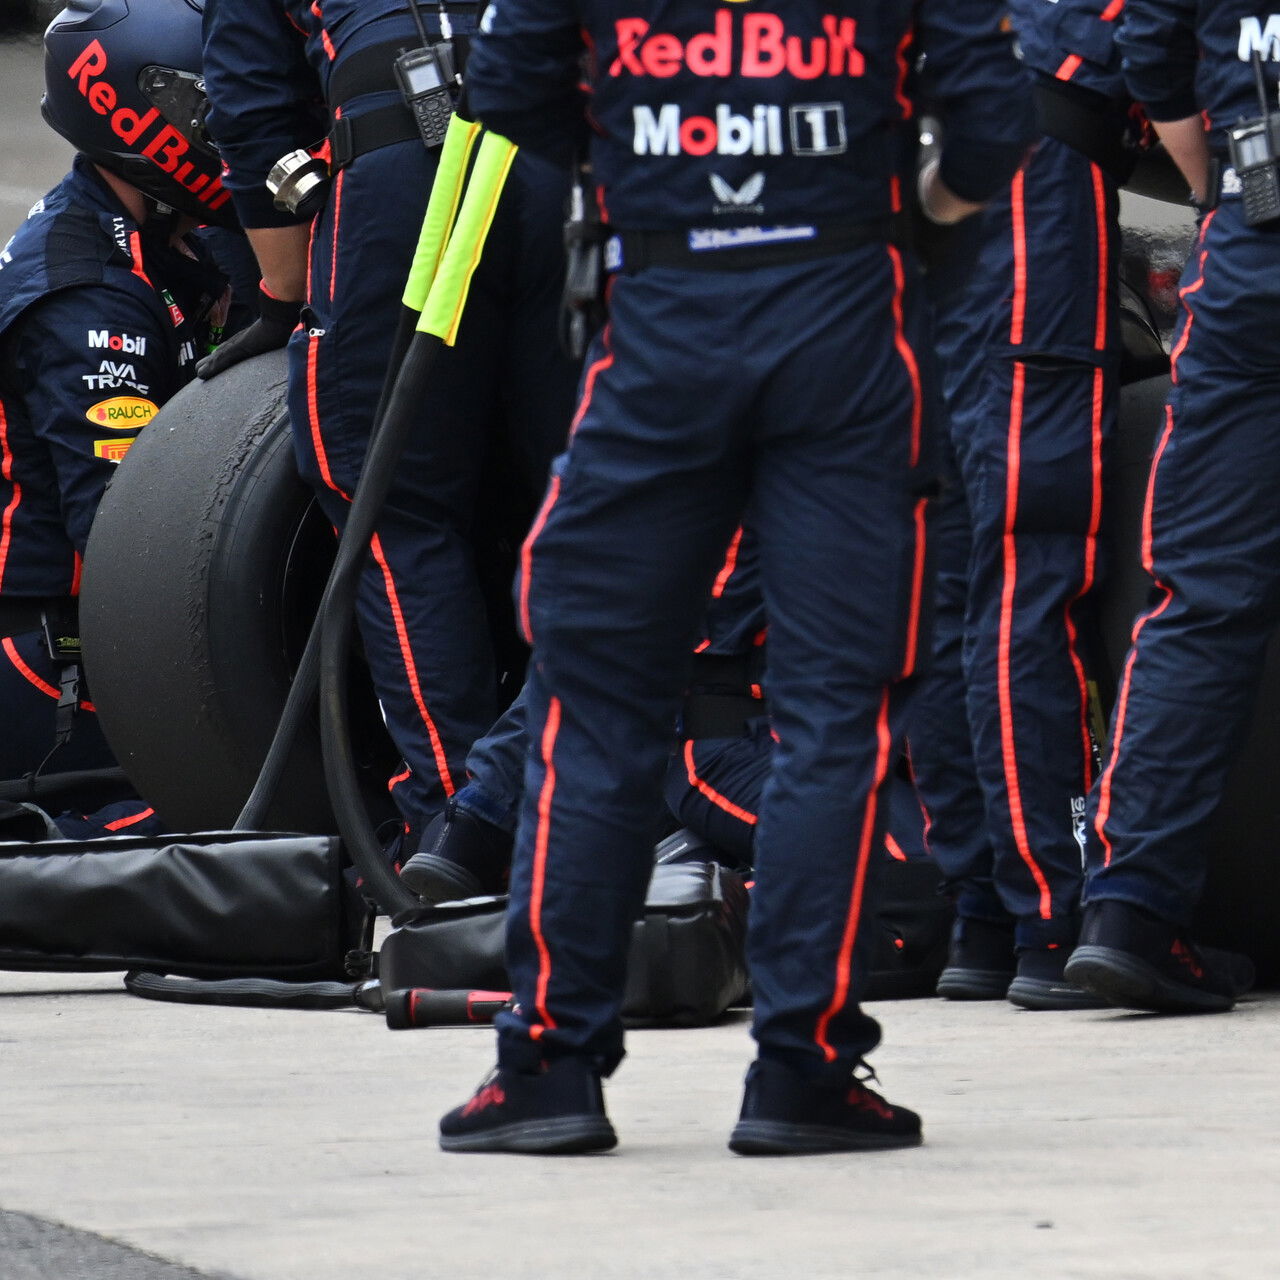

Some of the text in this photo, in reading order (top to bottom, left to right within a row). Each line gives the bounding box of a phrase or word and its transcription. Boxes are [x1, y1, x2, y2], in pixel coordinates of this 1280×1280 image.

[608, 8, 865, 79] Red Bull
[67, 39, 232, 211] Red Bull
[633, 104, 784, 156] Mobil
[88, 330, 146, 356] Mobil
[99, 360, 136, 380] AVA
[108, 406, 152, 419] RAUCH
